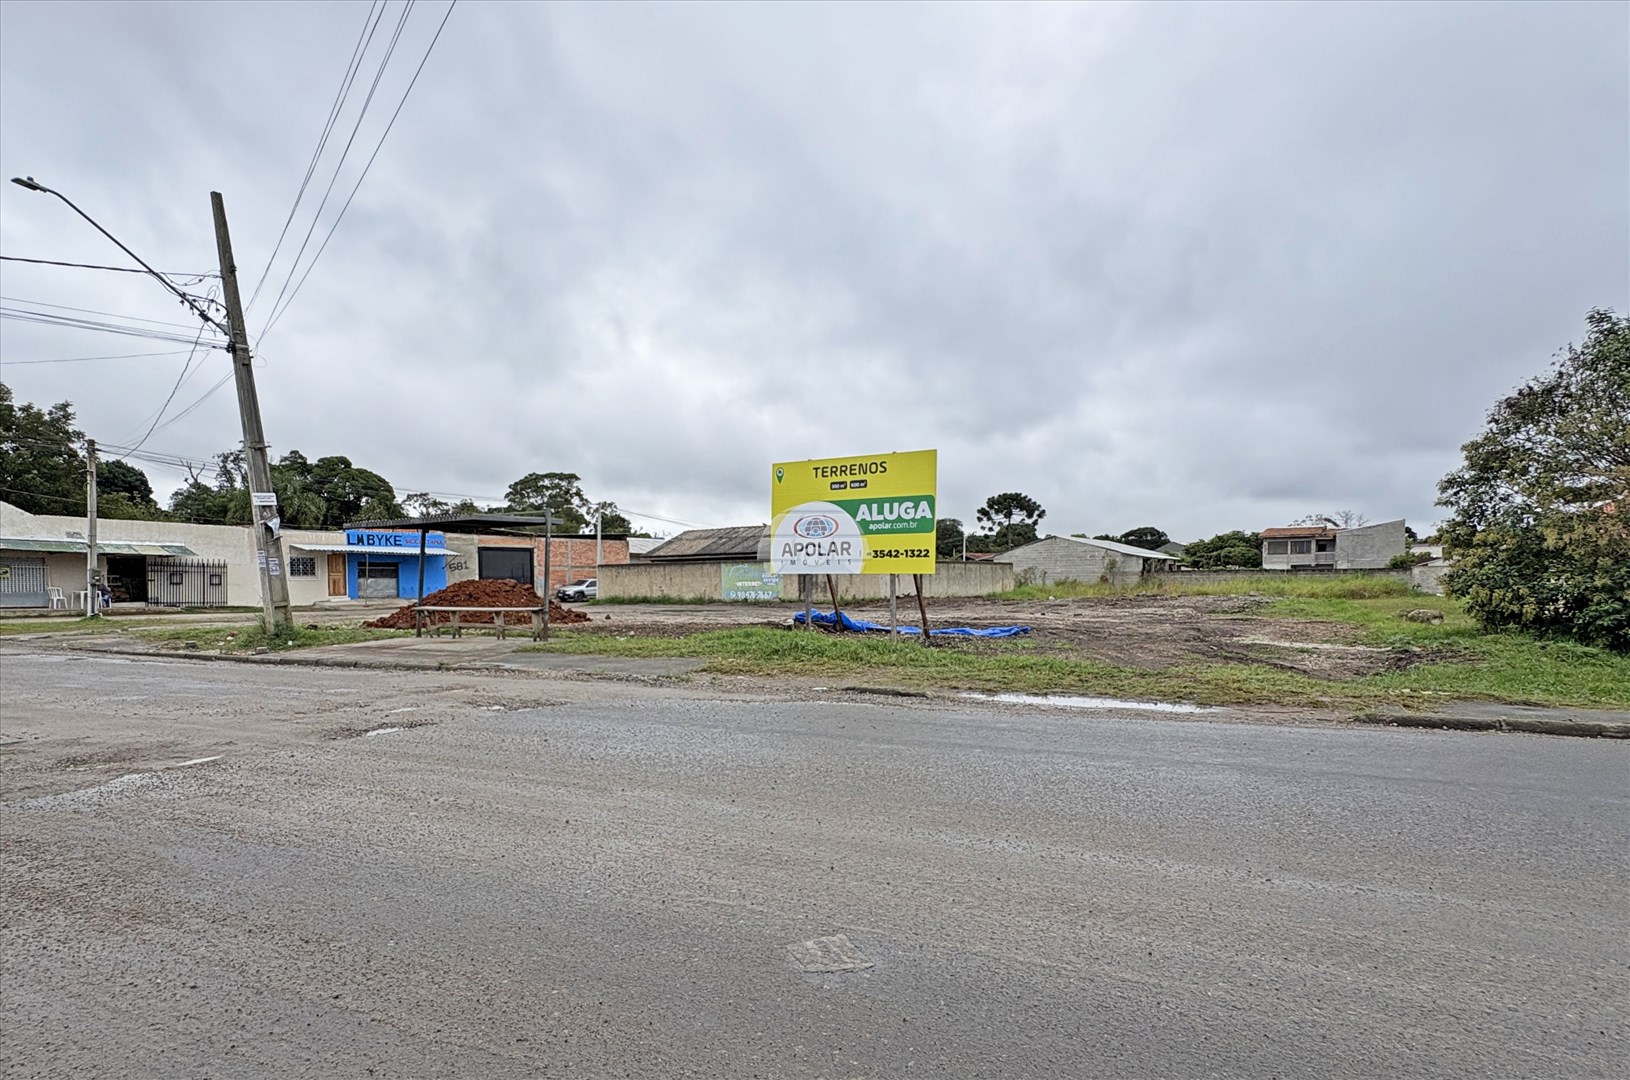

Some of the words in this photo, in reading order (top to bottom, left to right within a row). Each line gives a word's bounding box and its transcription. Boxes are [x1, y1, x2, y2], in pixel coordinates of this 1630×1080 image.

[813, 461, 887, 478] TERRENOS
[856, 501, 932, 521] ALUGA
[869, 521, 917, 531] apolar.com.br
[781, 541, 851, 557] APOLAR
[872, 549, 930, 558] 3542-1322
[449, 561, 469, 572] 581
